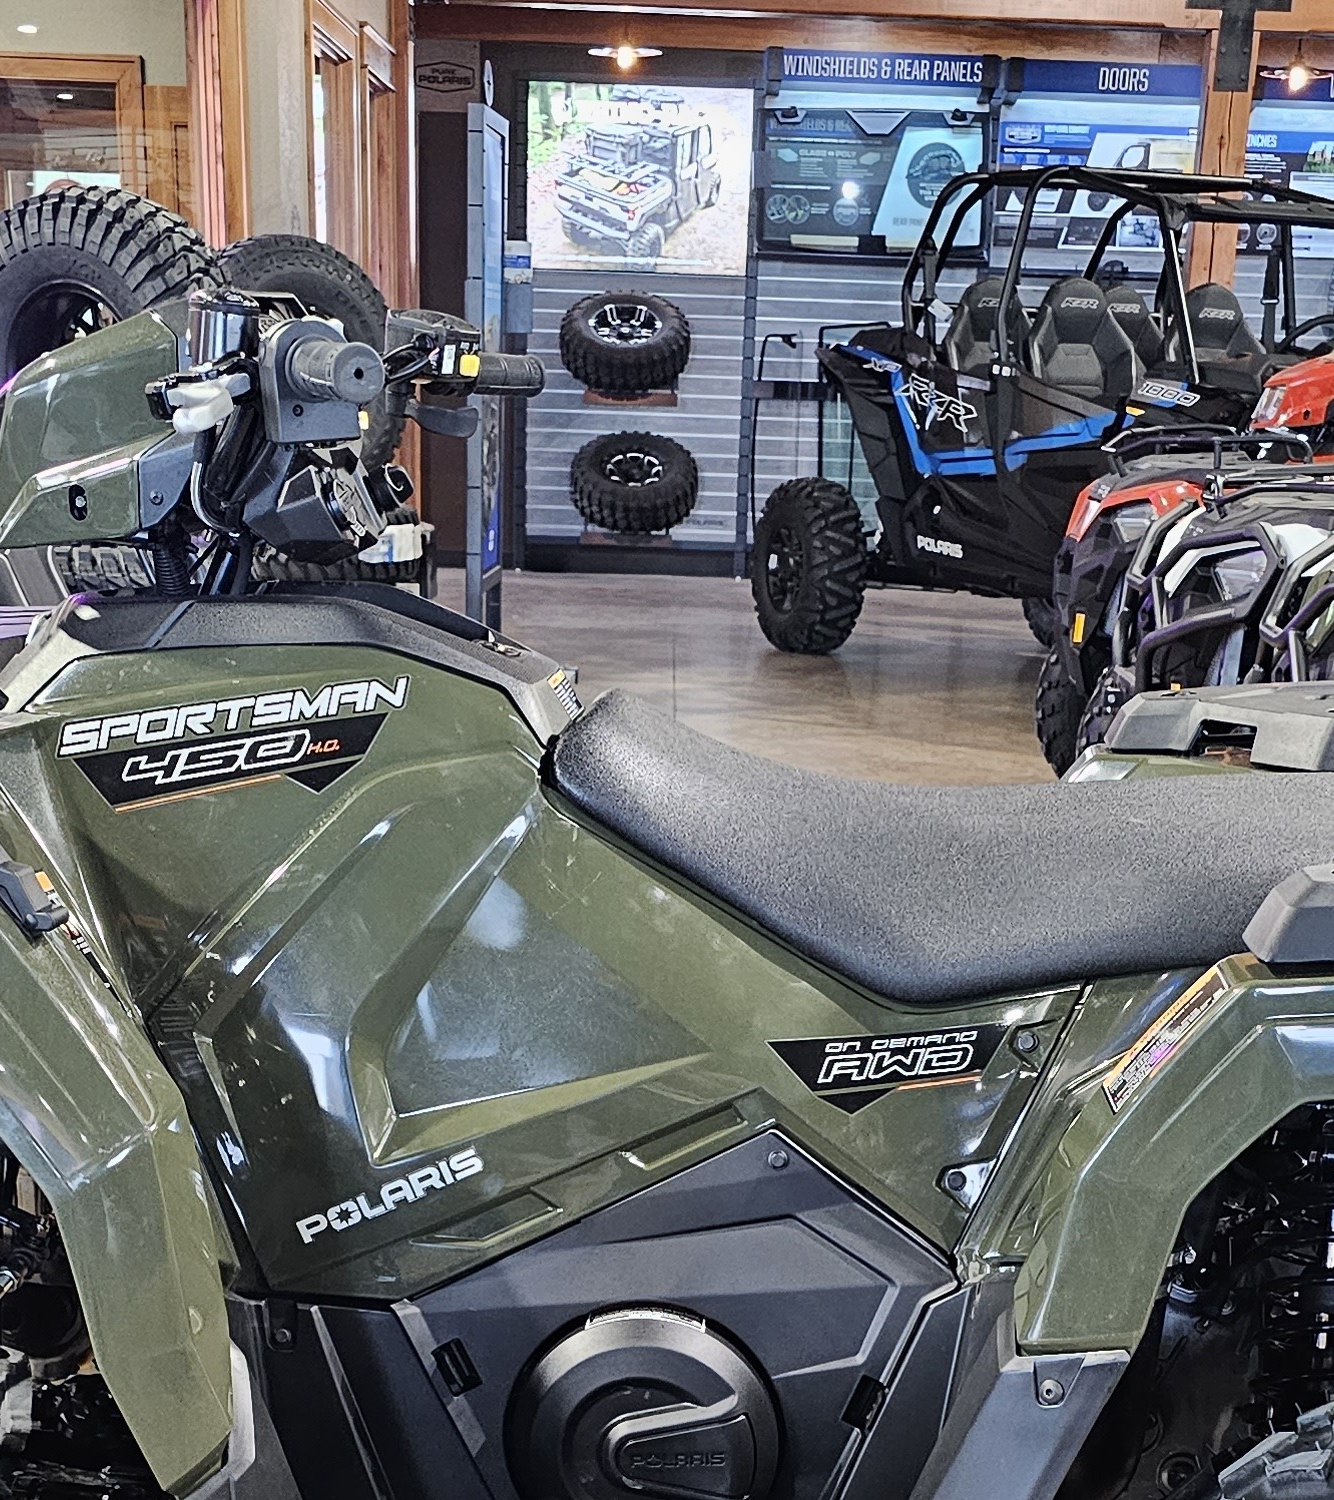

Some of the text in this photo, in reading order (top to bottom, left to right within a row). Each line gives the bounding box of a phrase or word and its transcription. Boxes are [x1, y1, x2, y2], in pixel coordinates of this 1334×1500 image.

[418, 75, 471, 85] POLARIS
[783, 54, 983, 83] WINDSHIELDS & REAR PANELS
[1098, 67, 1149, 91] DOORS
[1245, 134, 1278, 148] INCHES
[1060, 297, 1100, 310] RZR
[1199, 307, 1236, 320] RZR
[895, 373, 978, 433] RZR
[1138, 381, 1201, 407] 1000
[917, 535, 963, 559] POLARIS
[57, 675, 411, 758] SPORTSMAN
[121, 728, 340, 785] 450 H.O.
[825, 1030, 978, 1053] ON DEMAND
[817, 1043, 974, 1084] AWD
[296, 1147, 485, 1244] POLARIS
[630, 1454, 726, 1469] POLARIS
